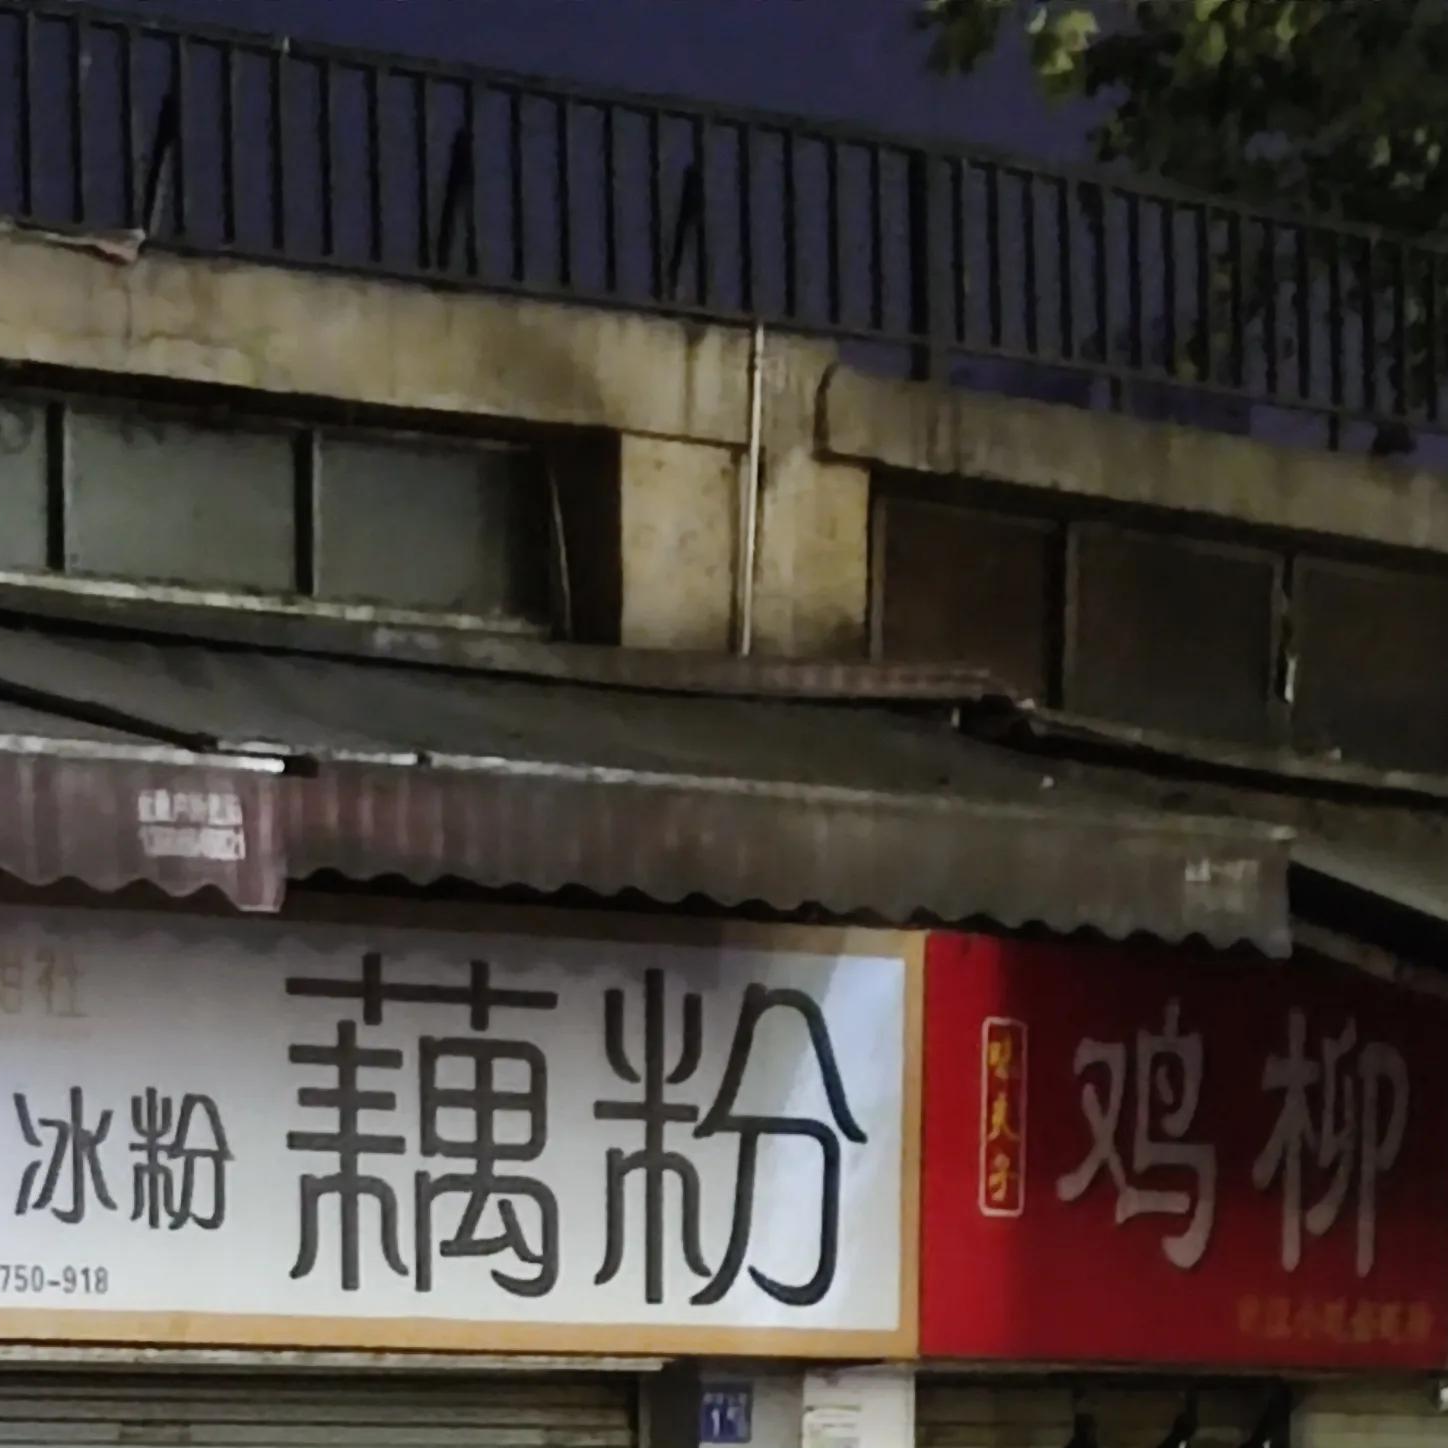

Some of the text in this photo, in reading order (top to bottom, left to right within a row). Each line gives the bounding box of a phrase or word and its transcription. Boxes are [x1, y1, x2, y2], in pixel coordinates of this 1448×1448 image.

[14, 1085, 235, 1230] 冰粉
[284, 952, 868, 1308] 藕粉
[1056, 998, 1412, 1278] 鸡柳
